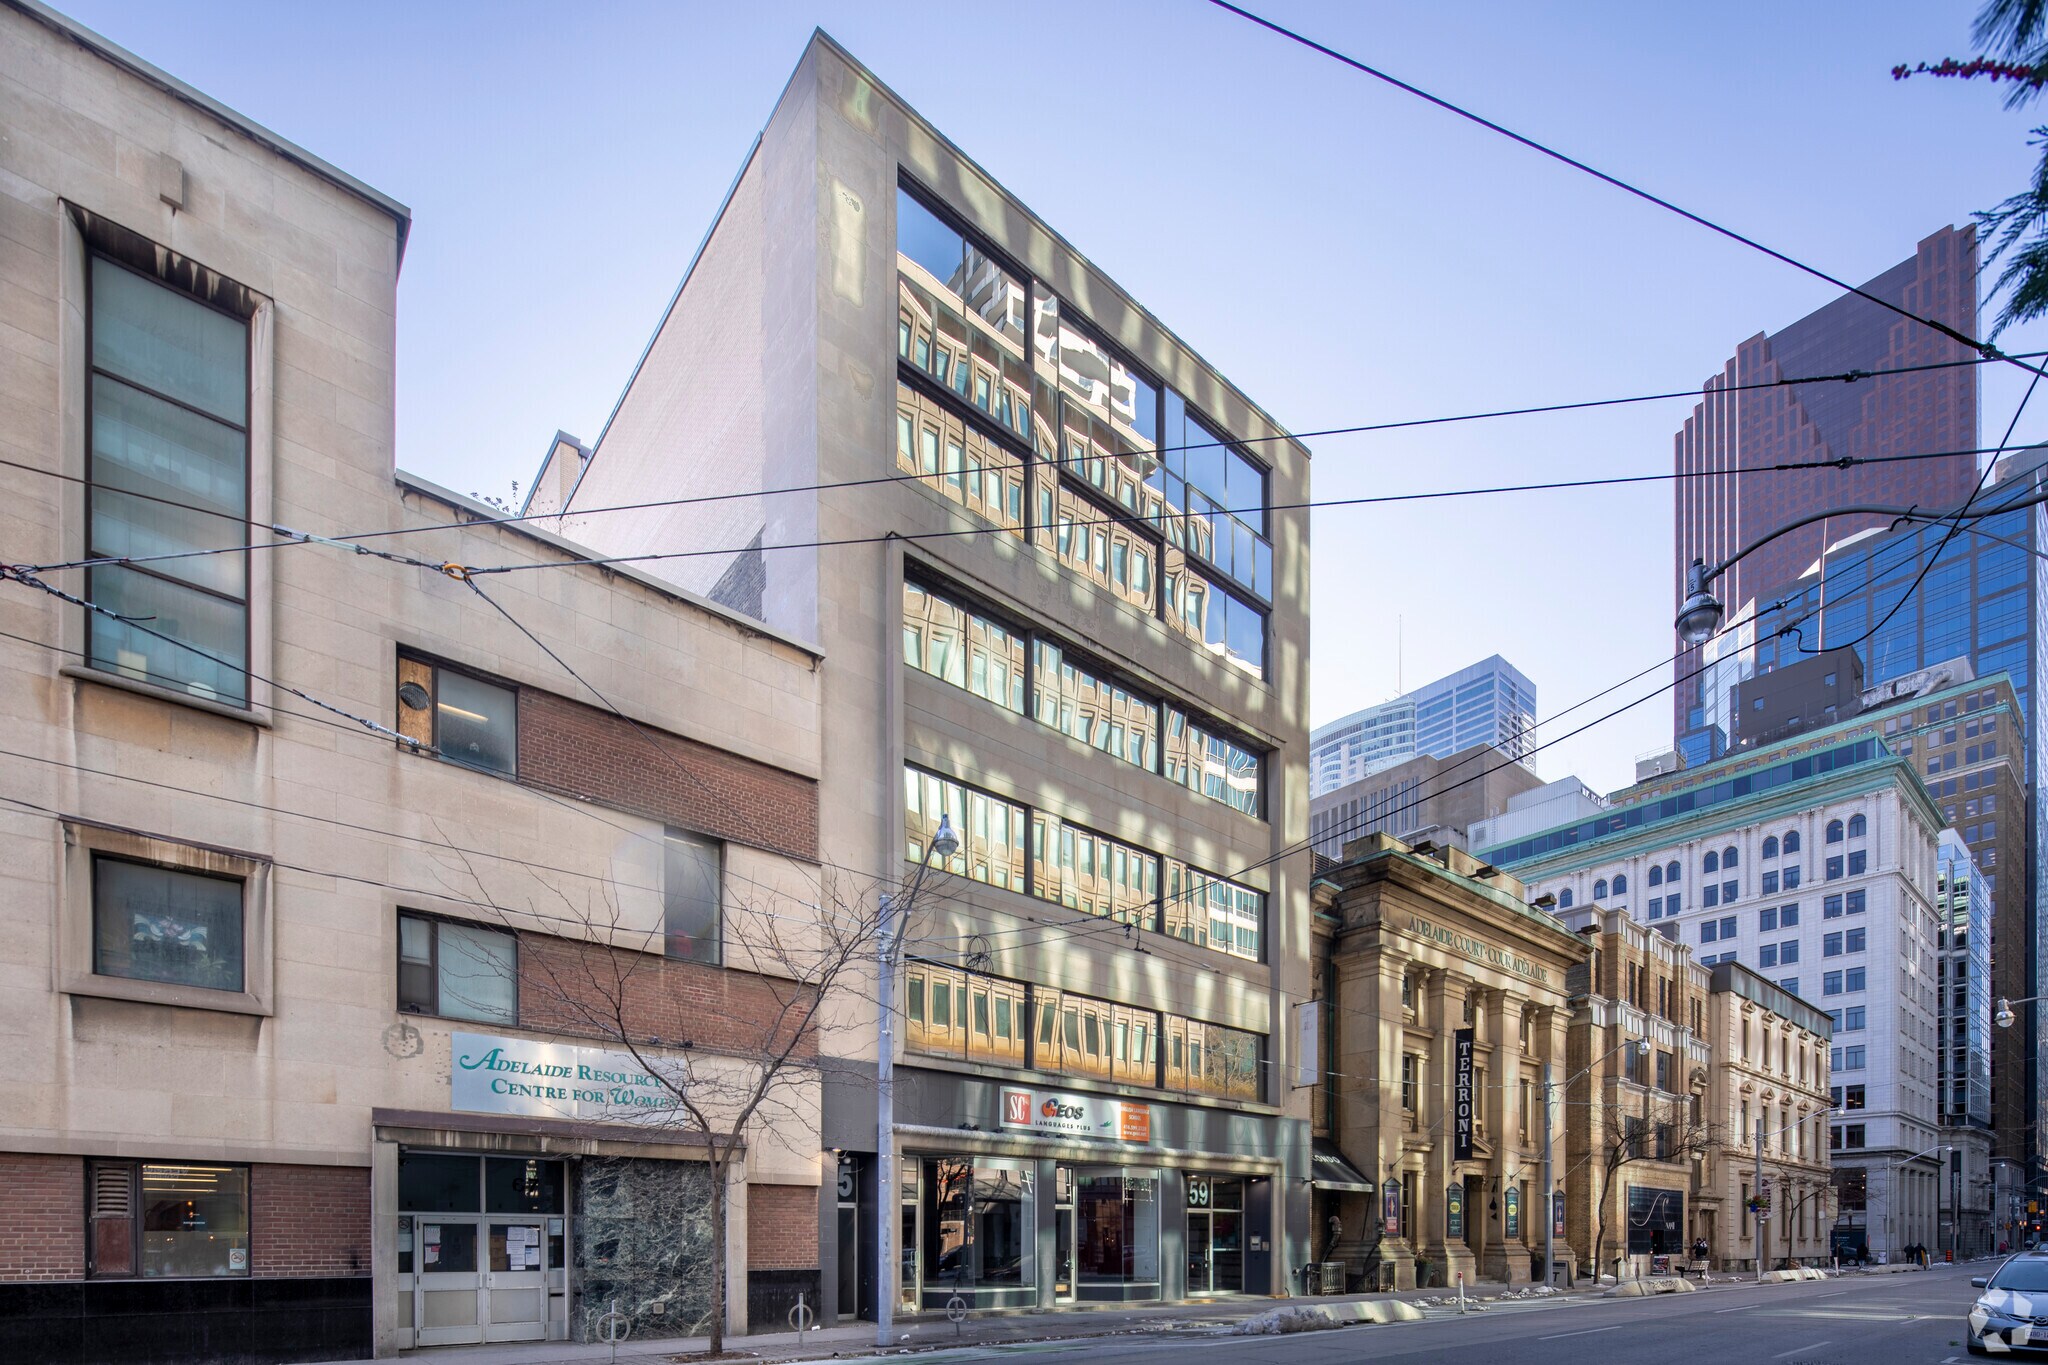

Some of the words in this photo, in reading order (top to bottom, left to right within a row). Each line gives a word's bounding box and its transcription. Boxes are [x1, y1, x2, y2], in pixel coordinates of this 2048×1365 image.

[1409, 916, 1453, 946] ADELAIDE
[1453, 934, 1486, 958] COURT
[1488, 948, 1511, 969] COUR
[459, 1048, 573, 1079] ADELAIDE
[577, 1064, 663, 1088] RESOURCE
[491, 1078, 567, 1100] CENTRE
[572, 1088, 605, 1103] FOR
[1458, 1042, 1470, 1147] TERRONI
[1042, 1098, 1084, 1120] GEOS
[1035, 1120, 1074, 1129] LANGUAGES
[838, 1165, 853, 1197] 5
[1189, 1181, 1208, 1205] 59
